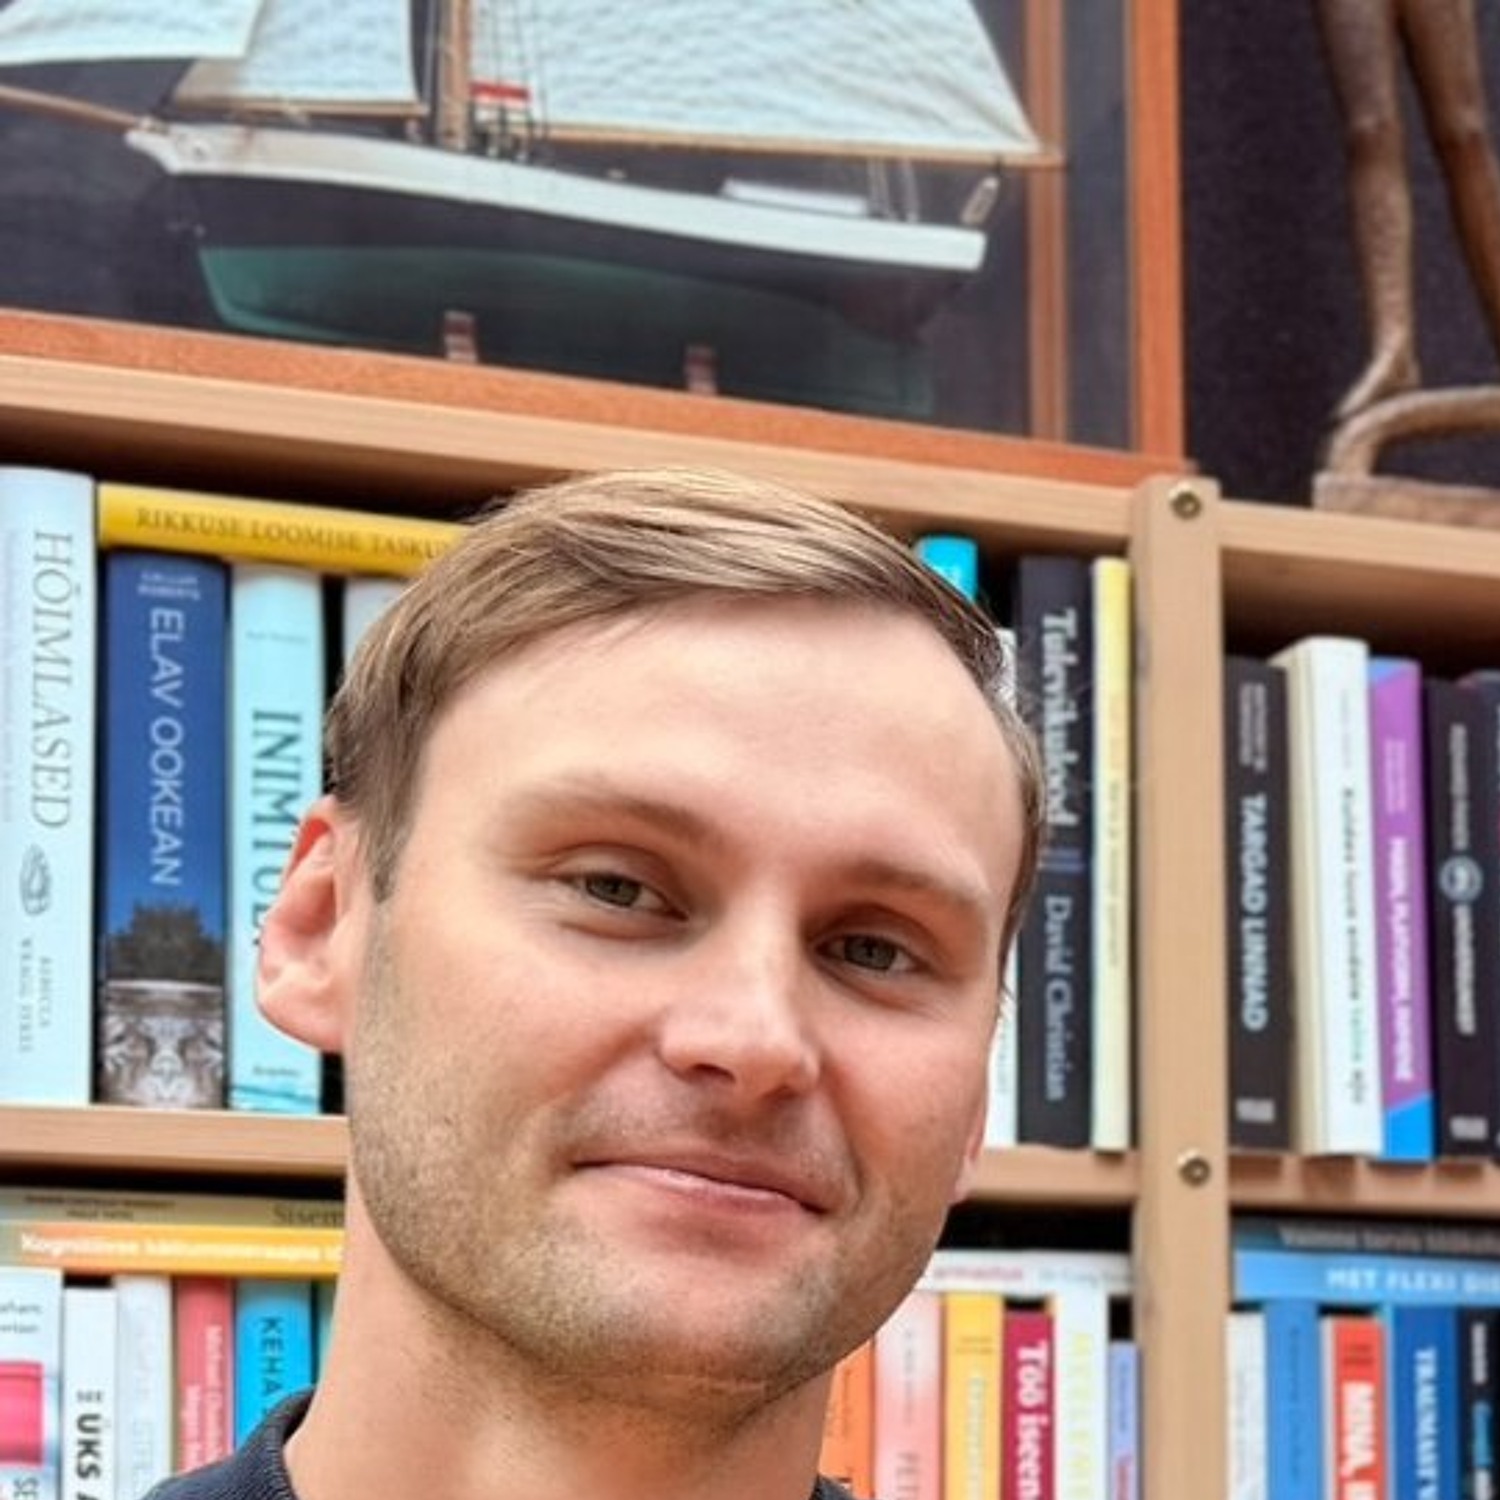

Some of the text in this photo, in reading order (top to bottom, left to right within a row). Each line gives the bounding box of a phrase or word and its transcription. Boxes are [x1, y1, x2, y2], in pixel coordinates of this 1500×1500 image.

[136, 506, 246, 542] RIKKUSE
[251, 518, 360, 553] LOOMISE
[32, 531, 80, 830] HÕIMLASED
[1042, 608, 1077, 826] Tulevikulood
[150, 608, 186, 887] ELAV OOKEAN
[1241, 794, 1267, 913] TARGAD
[1044, 895, 1070, 1101] David Christian
[1242, 917, 1269, 1032] LINNAD
[260, 1316, 286, 1396] KEHA
[1017, 1340, 1048, 1408] Töö
[76, 1410, 108, 1480] ÜKS
